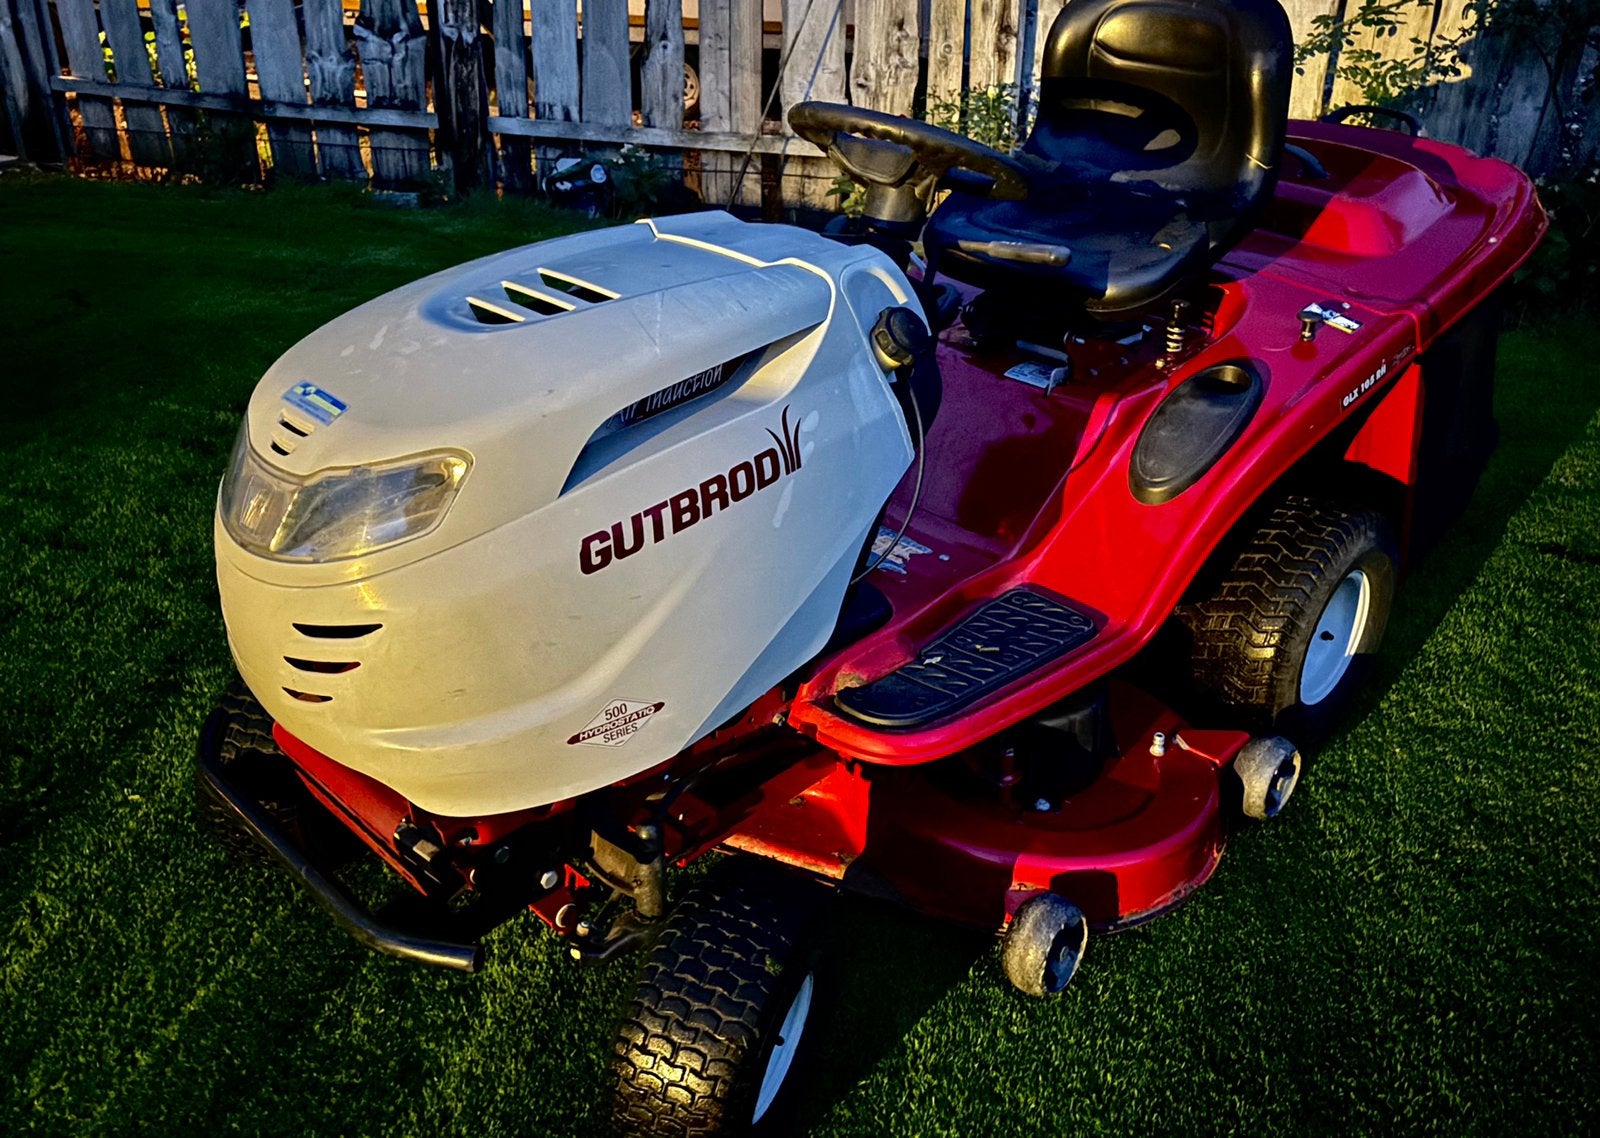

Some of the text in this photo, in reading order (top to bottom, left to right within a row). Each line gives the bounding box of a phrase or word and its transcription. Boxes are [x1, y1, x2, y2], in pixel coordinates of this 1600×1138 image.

[1343, 388, 1358, 407] GLX
[1361, 374, 1375, 392] 105
[579, 447, 780, 575] GUTBROD
[579, 706, 656, 741] HYDROSTATIC
[604, 703, 628, 721] 500
[603, 722, 638, 743] SERIES
